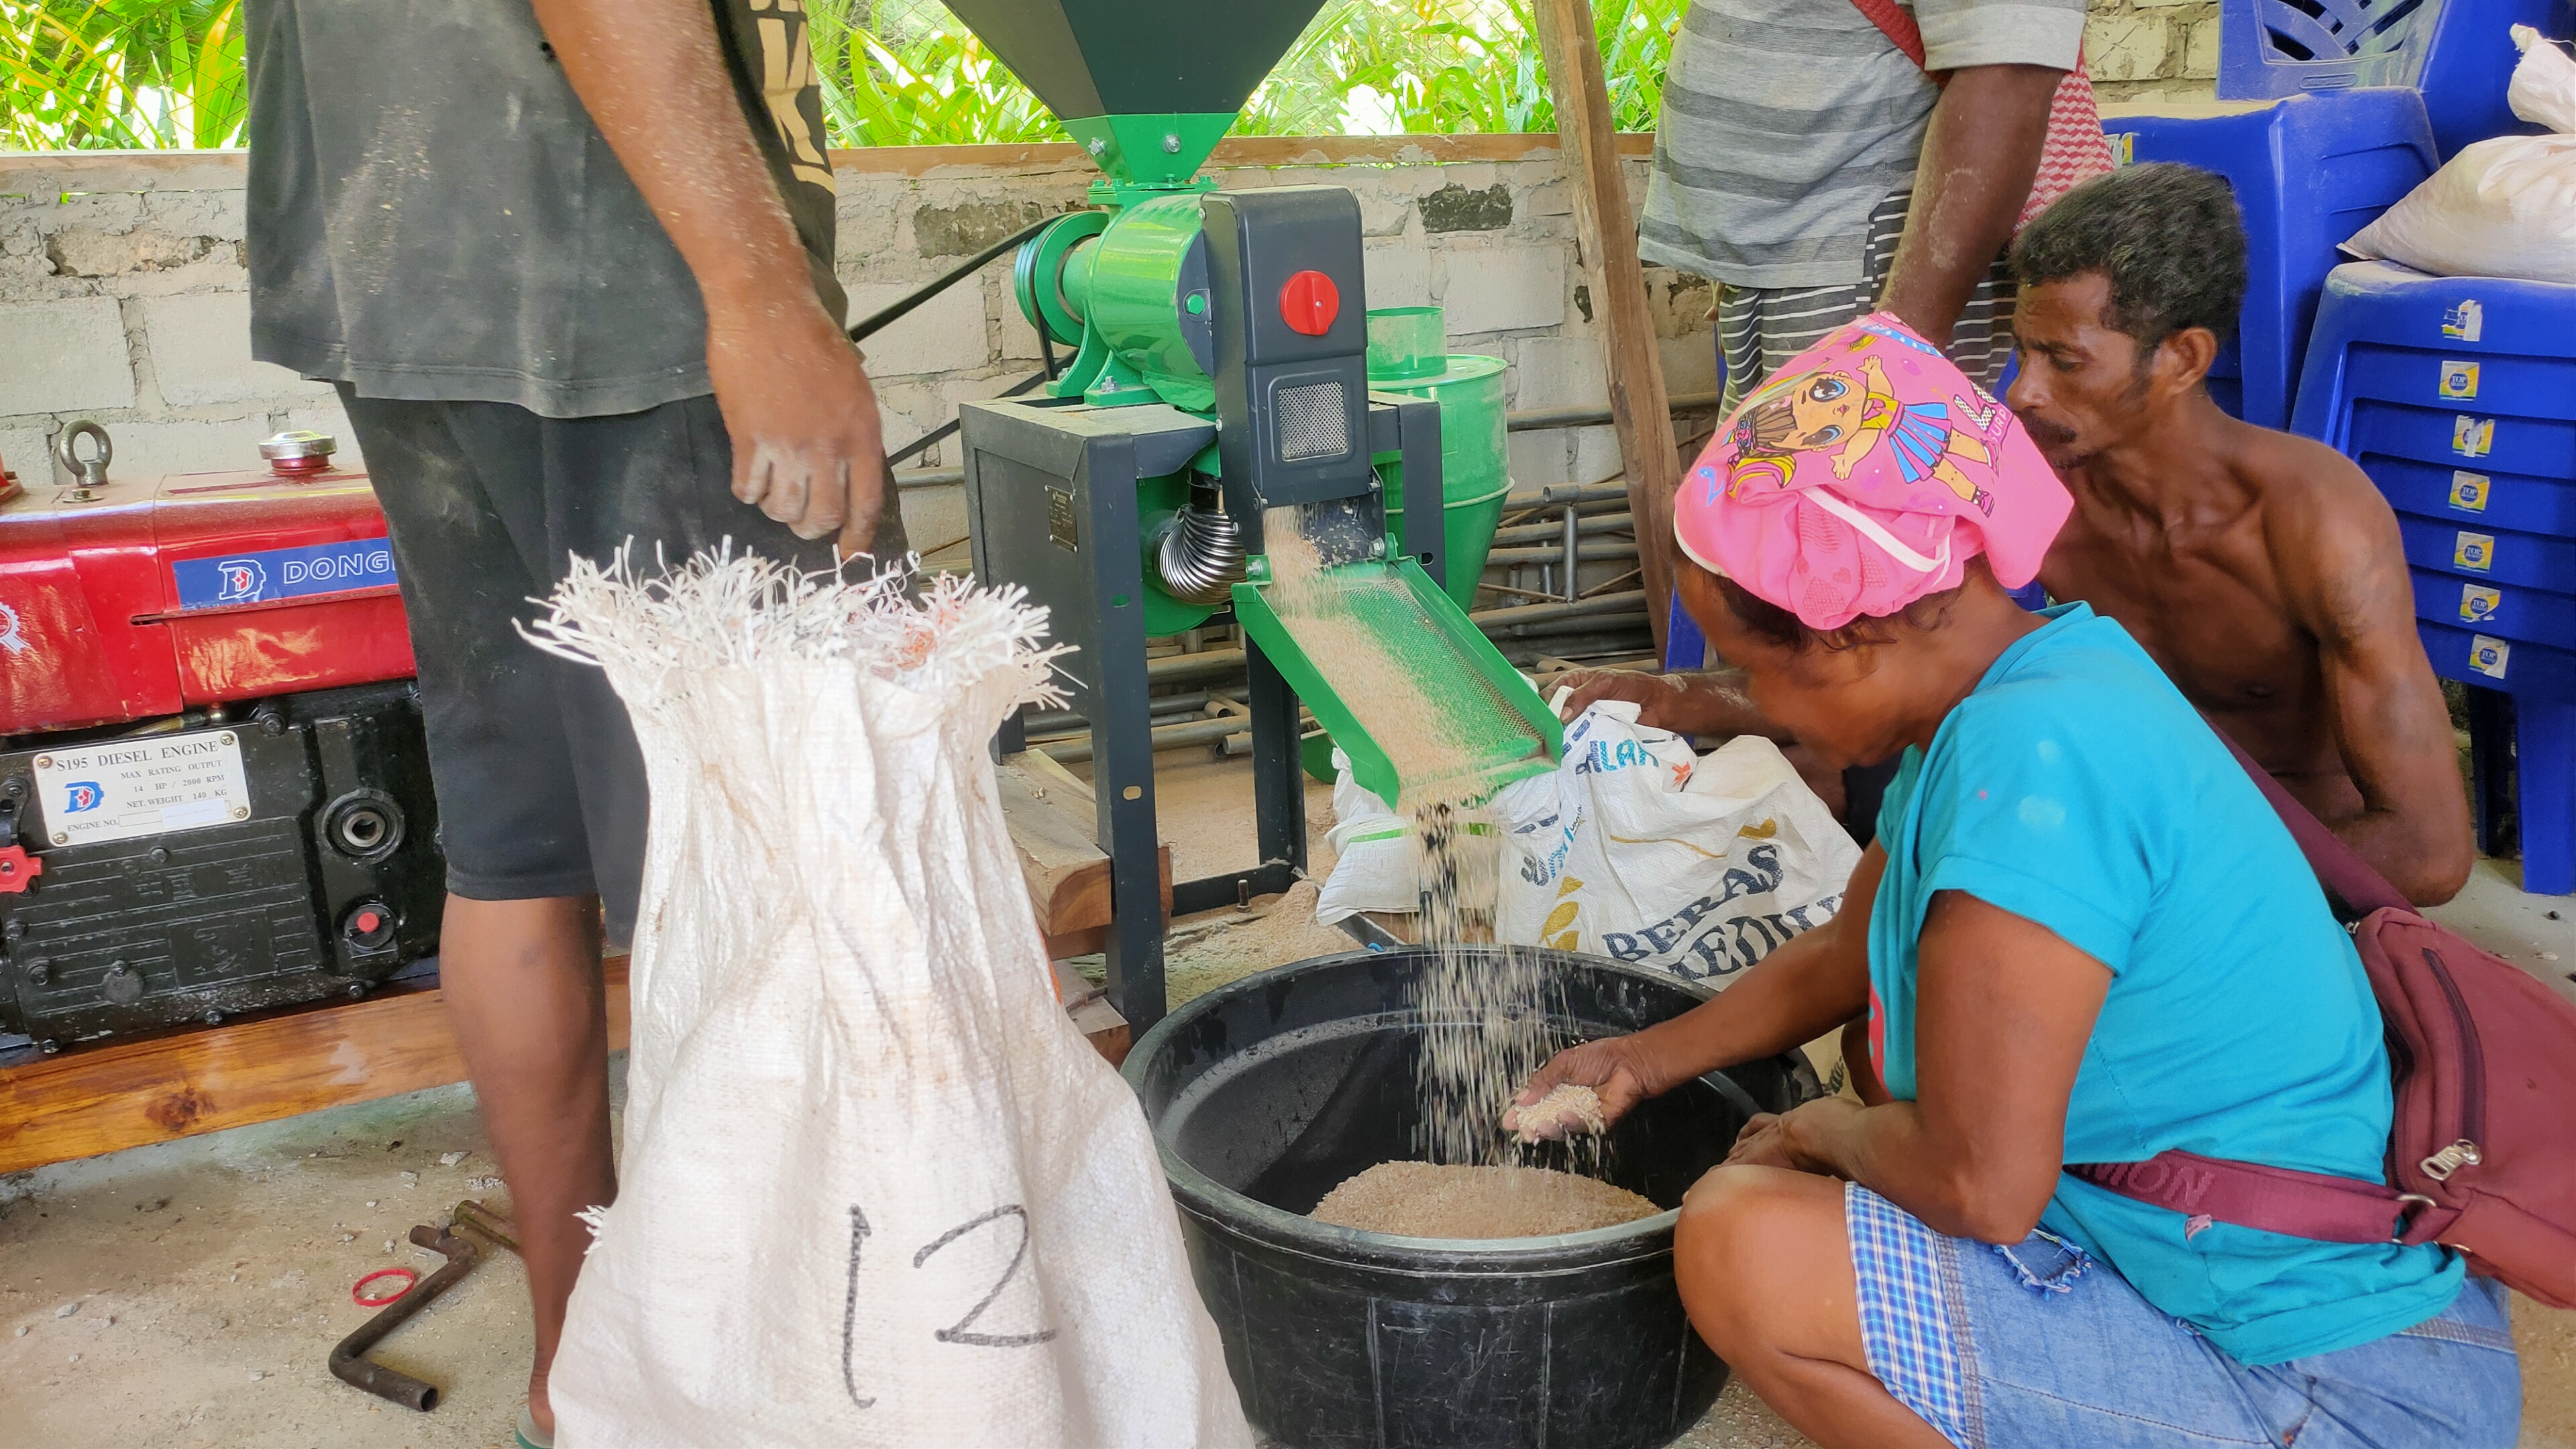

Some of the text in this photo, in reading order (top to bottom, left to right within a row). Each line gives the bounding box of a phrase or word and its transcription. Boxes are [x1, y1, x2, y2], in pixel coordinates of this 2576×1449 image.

[2451, 375, 2467, 384] TOP
[2462, 486, 2477, 496] TOP
[2467, 547, 2482, 555] TOP
[283, 550, 396, 584] DONG
[2473, 599, 2487, 607] TOP
[2481, 649, 2496, 658] TOP
[56, 741, 219, 772] S195 DIESEL ENGINE
[121, 759, 222, 780] MAX RATING OUTPUT
[134, 786, 144, 794] 14
[155, 782, 168, 790] HP
[182, 777, 202, 787] 2000
[206, 774, 225, 784] RPM
[193, 792, 207, 800] 140
[215, 789, 227, 797] KG
[66, 818, 119, 833] ENGINE NO.
[1602, 845, 1784, 962] BERAS
[843, 1203, 1057, 1409] 12
